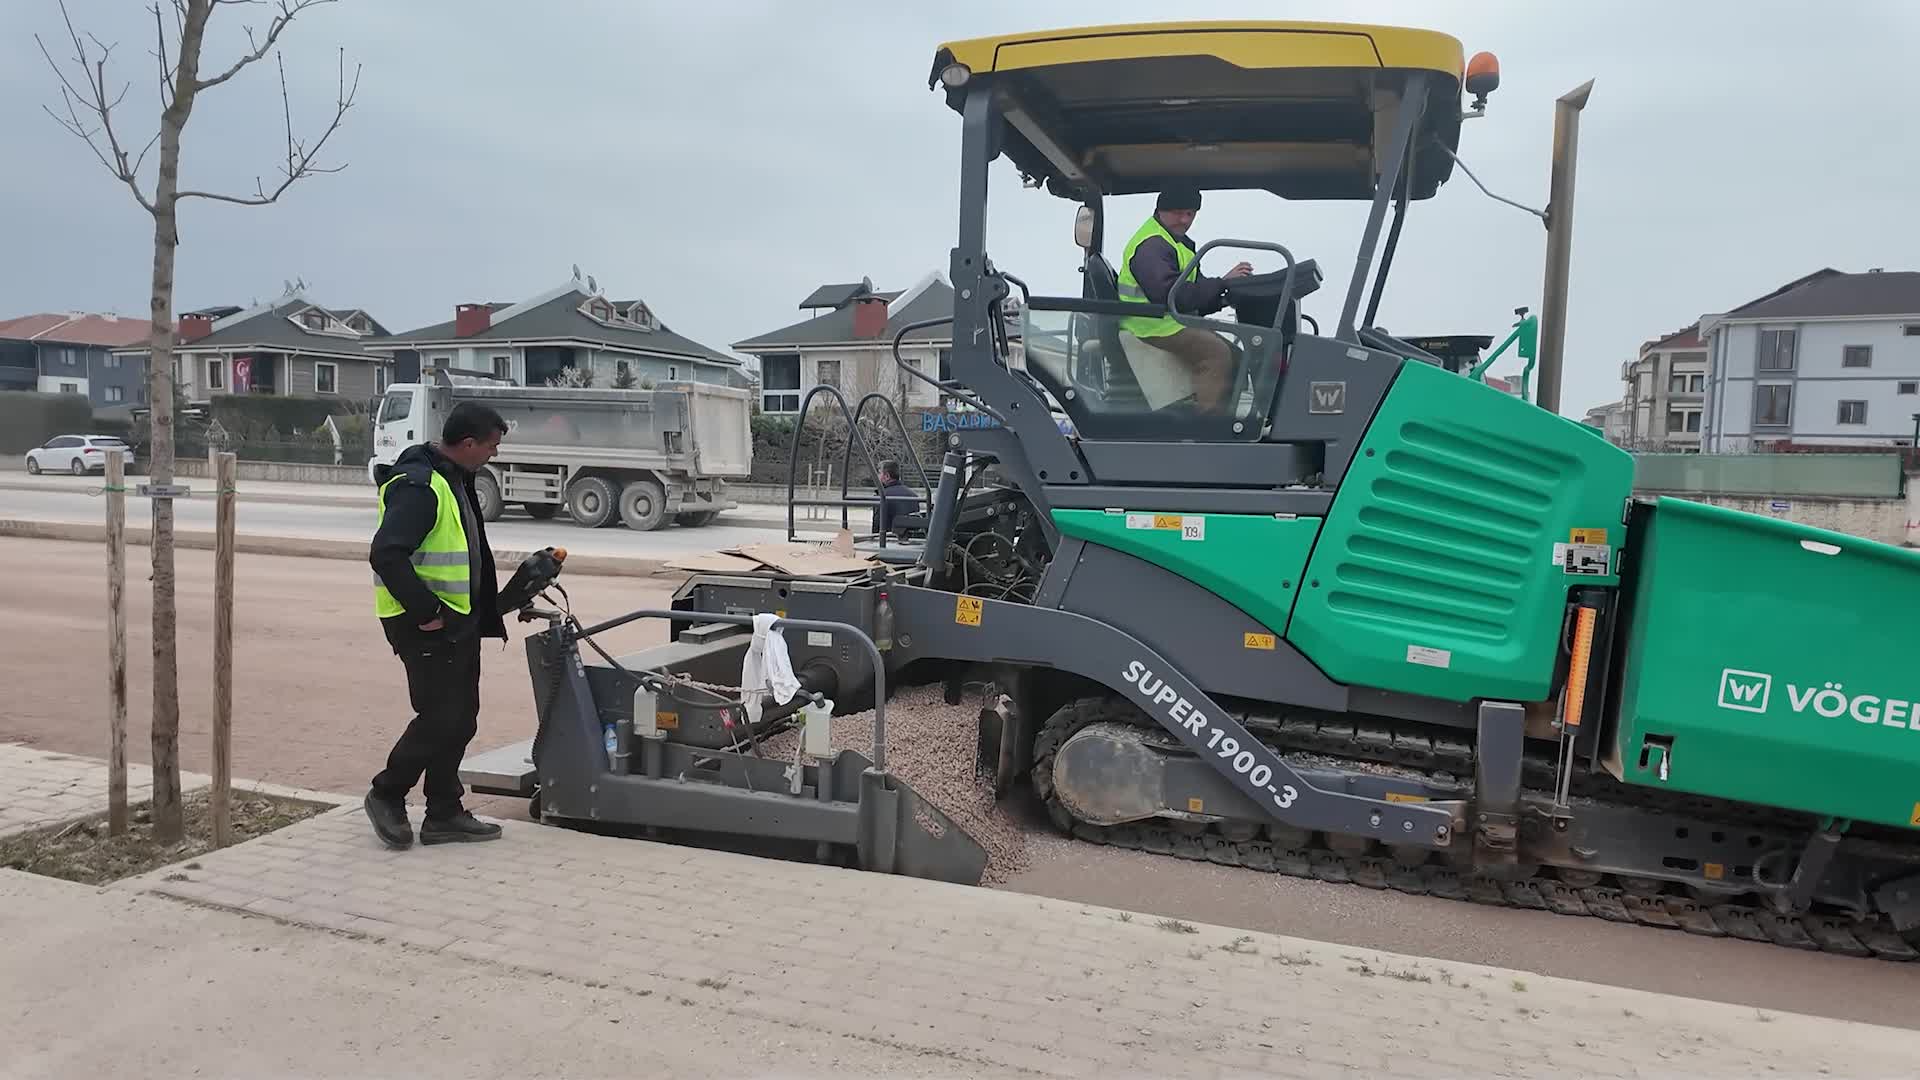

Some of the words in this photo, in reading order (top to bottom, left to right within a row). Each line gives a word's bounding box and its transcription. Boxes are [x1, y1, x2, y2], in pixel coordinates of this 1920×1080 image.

[1184, 526, 1199, 538] 109
[1121, 660, 1208, 737] SUPER
[1207, 728, 1298, 809] 1900-3
